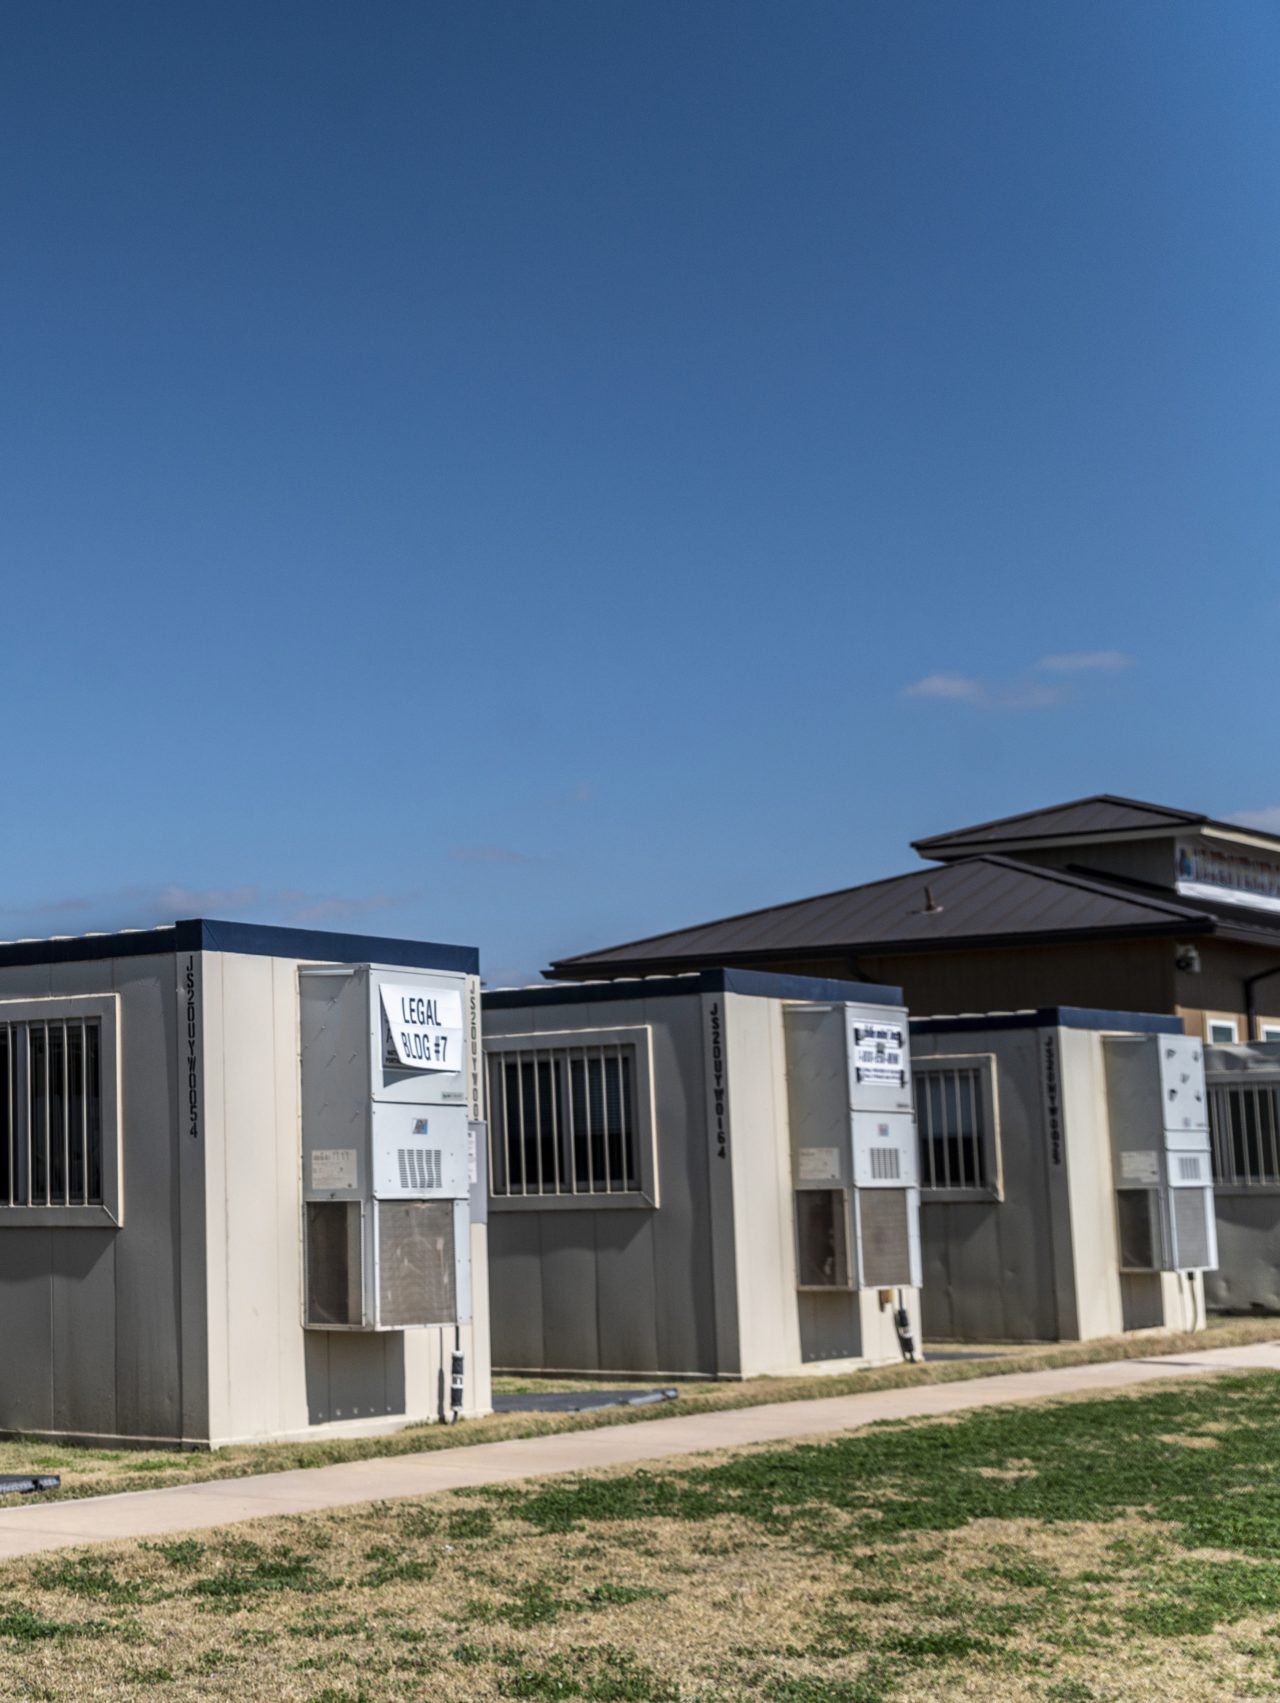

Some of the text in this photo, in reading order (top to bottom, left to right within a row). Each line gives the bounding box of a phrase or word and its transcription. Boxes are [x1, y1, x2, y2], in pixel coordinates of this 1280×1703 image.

[401, 997, 441, 1026] LEGAL
[401, 1032, 447, 1062] BLDG #7
